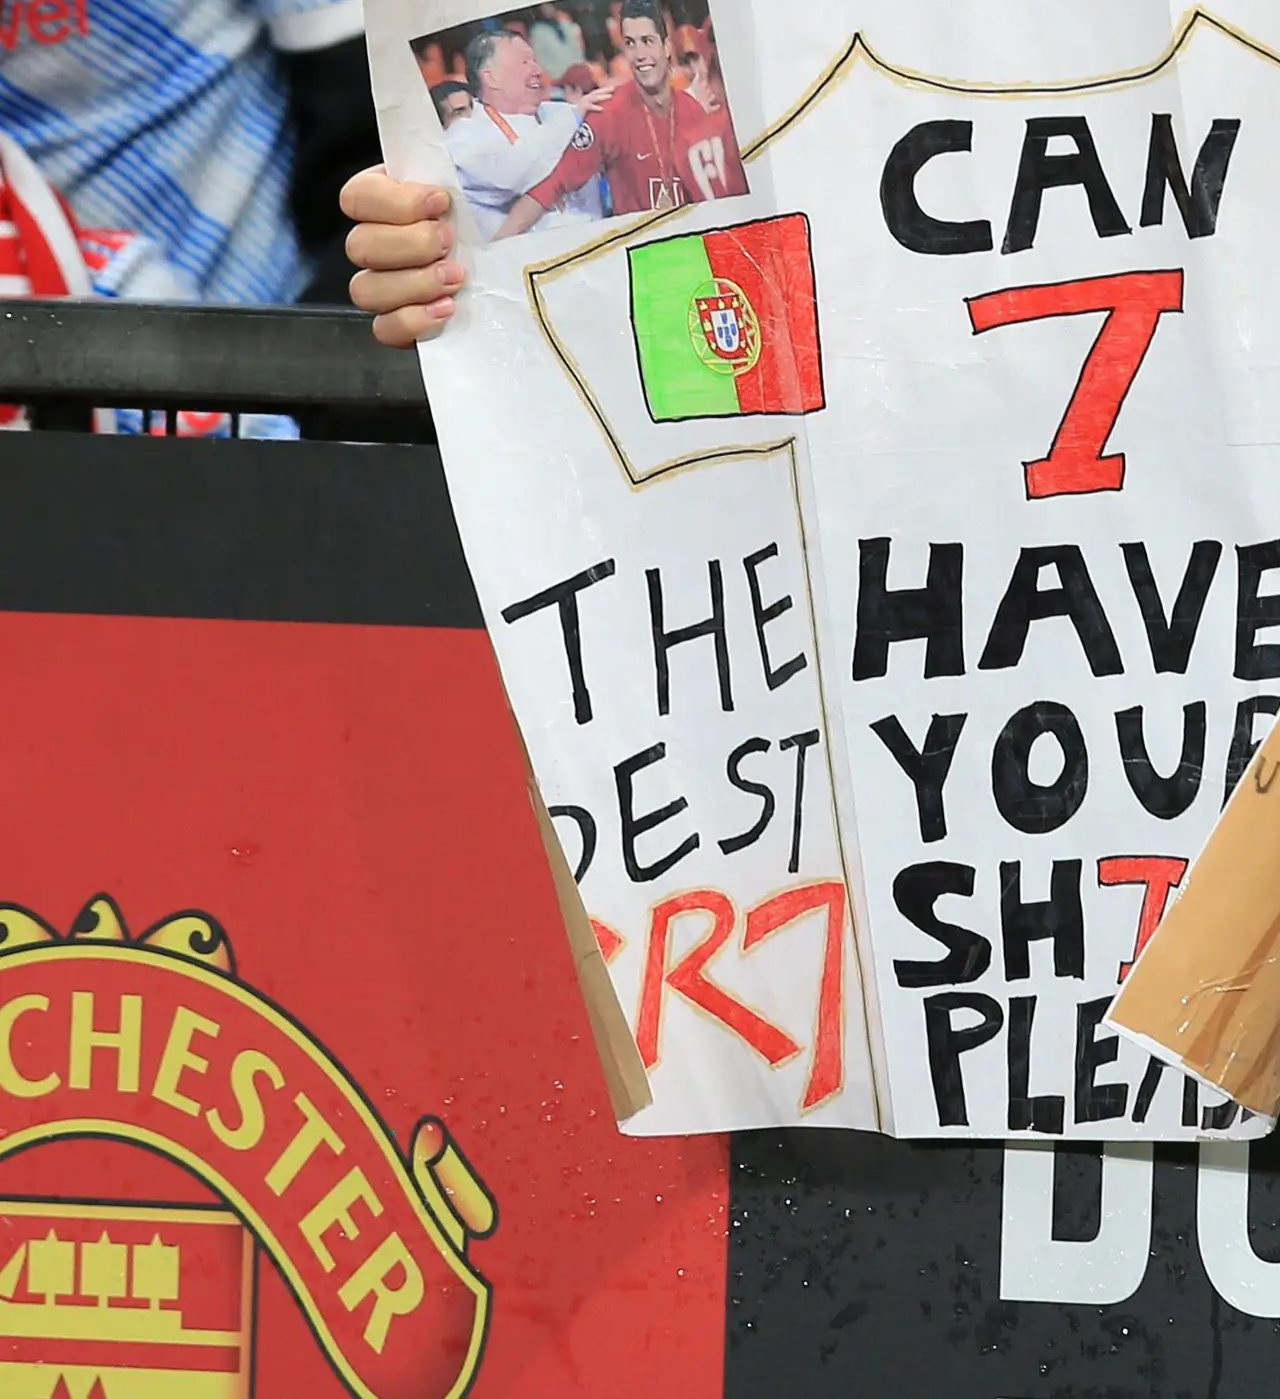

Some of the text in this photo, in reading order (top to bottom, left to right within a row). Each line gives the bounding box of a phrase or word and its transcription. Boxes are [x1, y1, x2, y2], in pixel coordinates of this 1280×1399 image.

[879, 112, 1242, 255] CAN
[965, 267, 1185, 500] 7
[500, 541, 809, 726] THE
[589, 877, 849, 1117] R7
[923, 991, 1258, 1134] PLE
